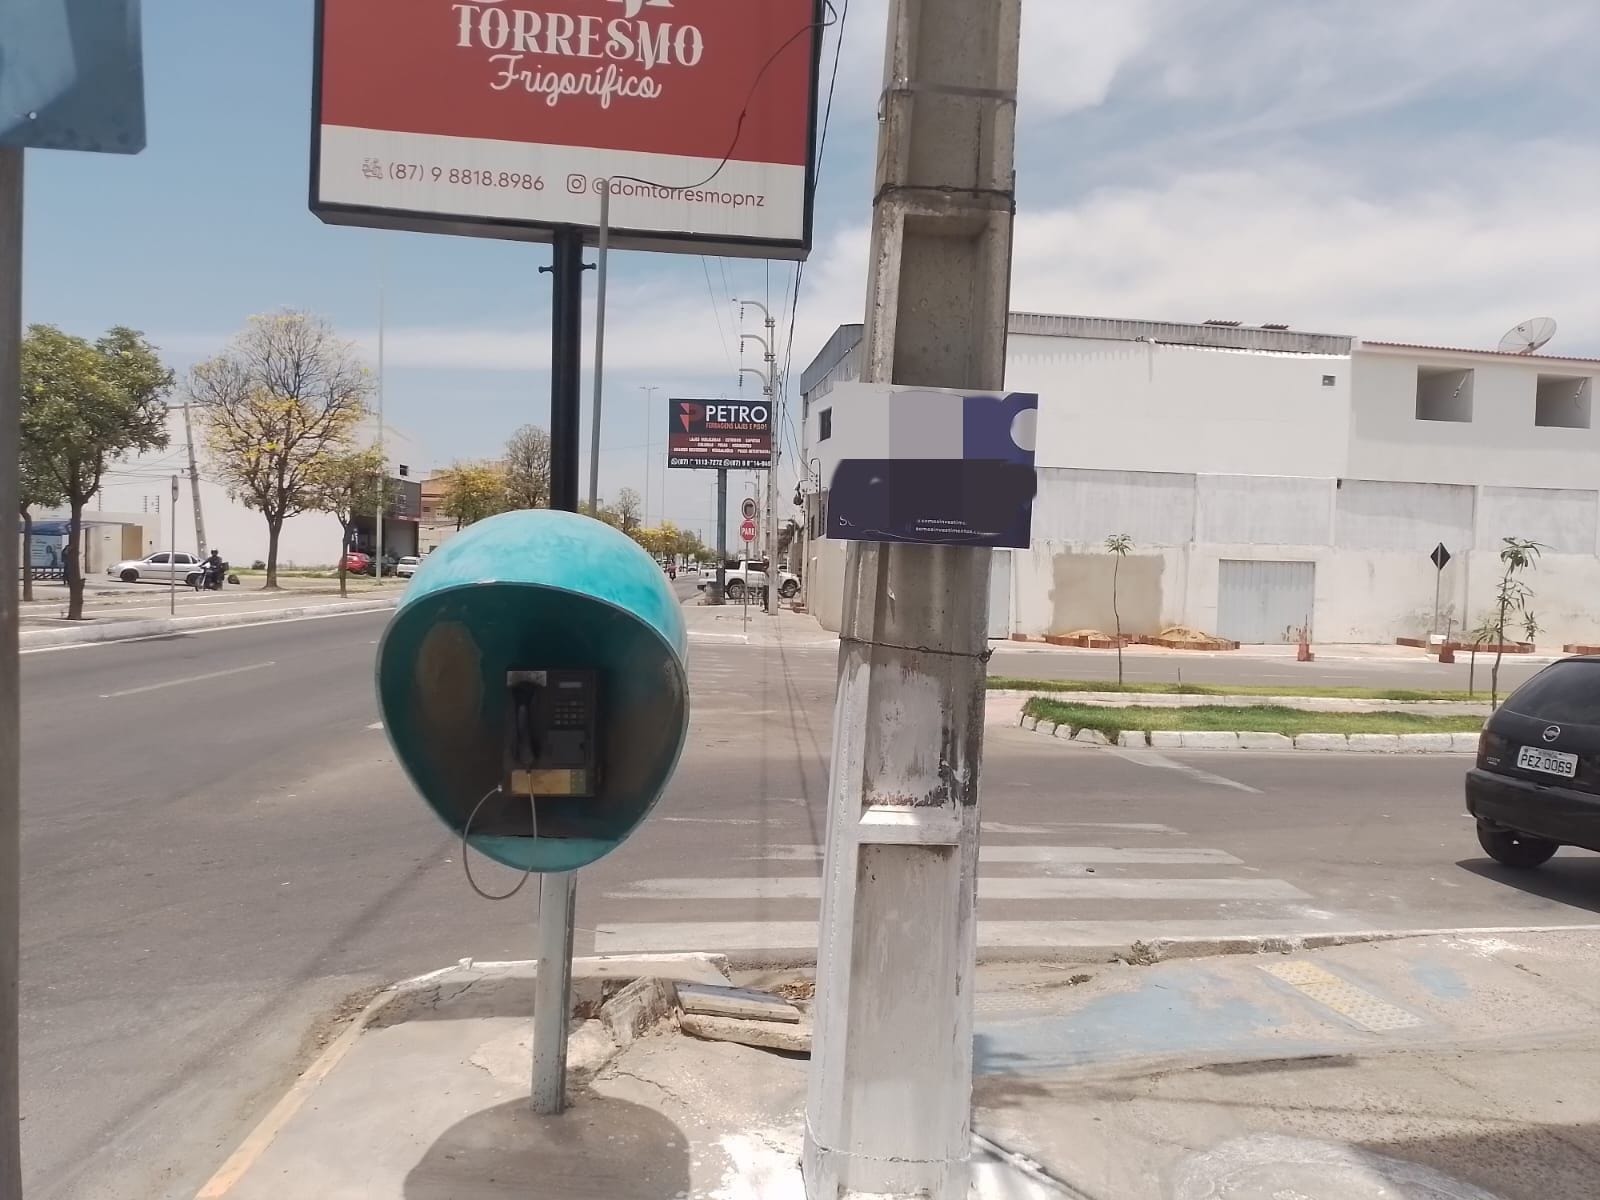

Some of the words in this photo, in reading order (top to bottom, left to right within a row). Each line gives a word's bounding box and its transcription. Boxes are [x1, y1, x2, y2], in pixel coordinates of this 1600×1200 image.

[452, 4, 704, 71] TORRESMO
[488, 54, 663, 109] Frigorífico
[389, 162, 424, 182] (87)
[431, 166, 442, 182] 9
[448, 168, 545, 191] 8818.8986
[706, 405, 768, 423] PETRO
[742, 527, 755, 536] PARE
